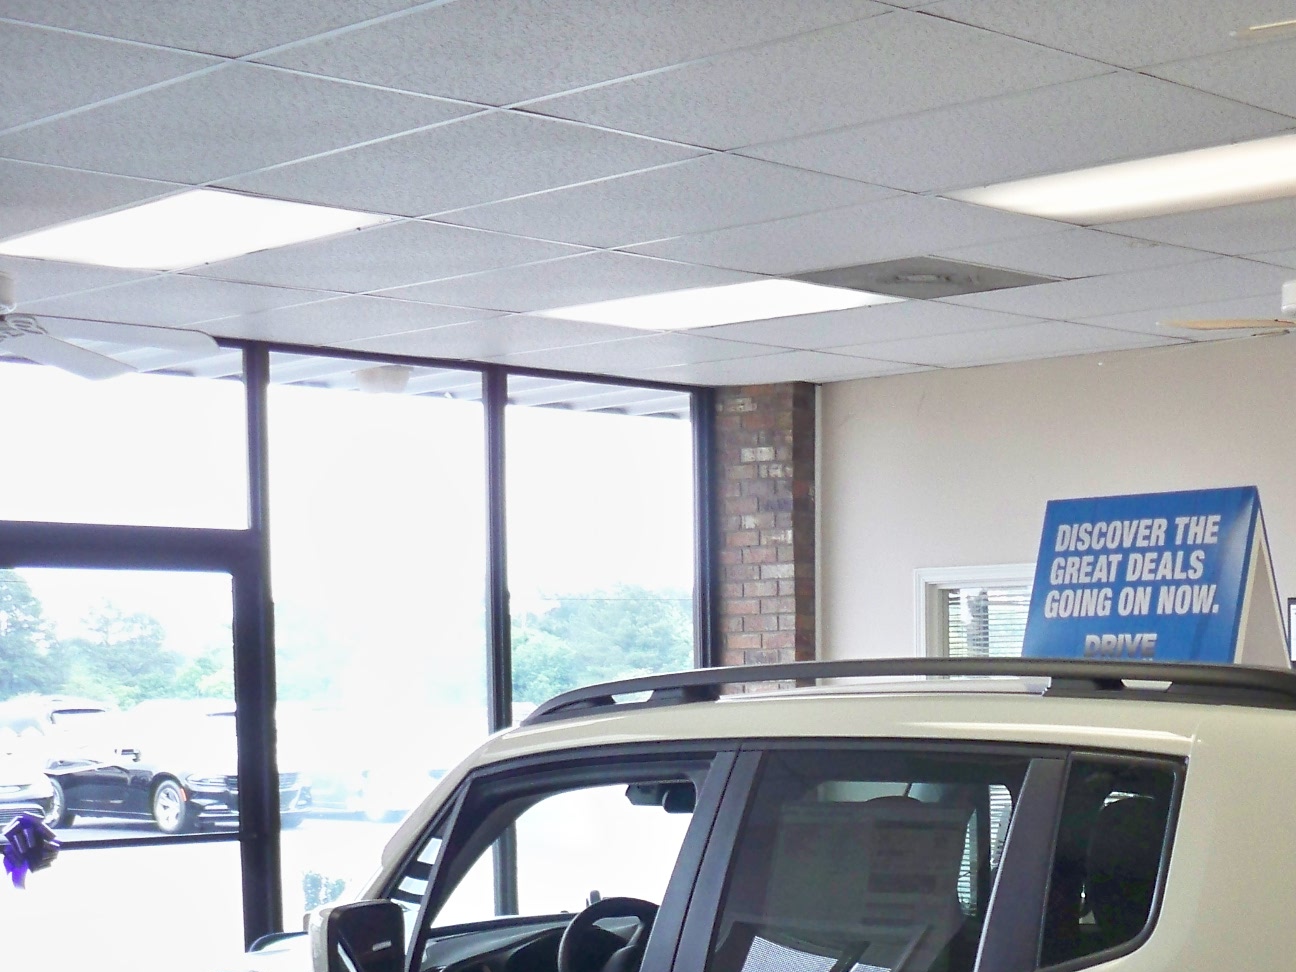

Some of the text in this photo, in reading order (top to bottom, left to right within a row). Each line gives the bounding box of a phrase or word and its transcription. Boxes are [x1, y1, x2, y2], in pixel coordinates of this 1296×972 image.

[1055, 514, 1221, 552] DISCOVER THE
[1050, 550, 1206, 585] GREAT DEALS
[1044, 584, 1220, 619] GOING ON NOW.
[1084, 633, 1158, 658] DRIVE
